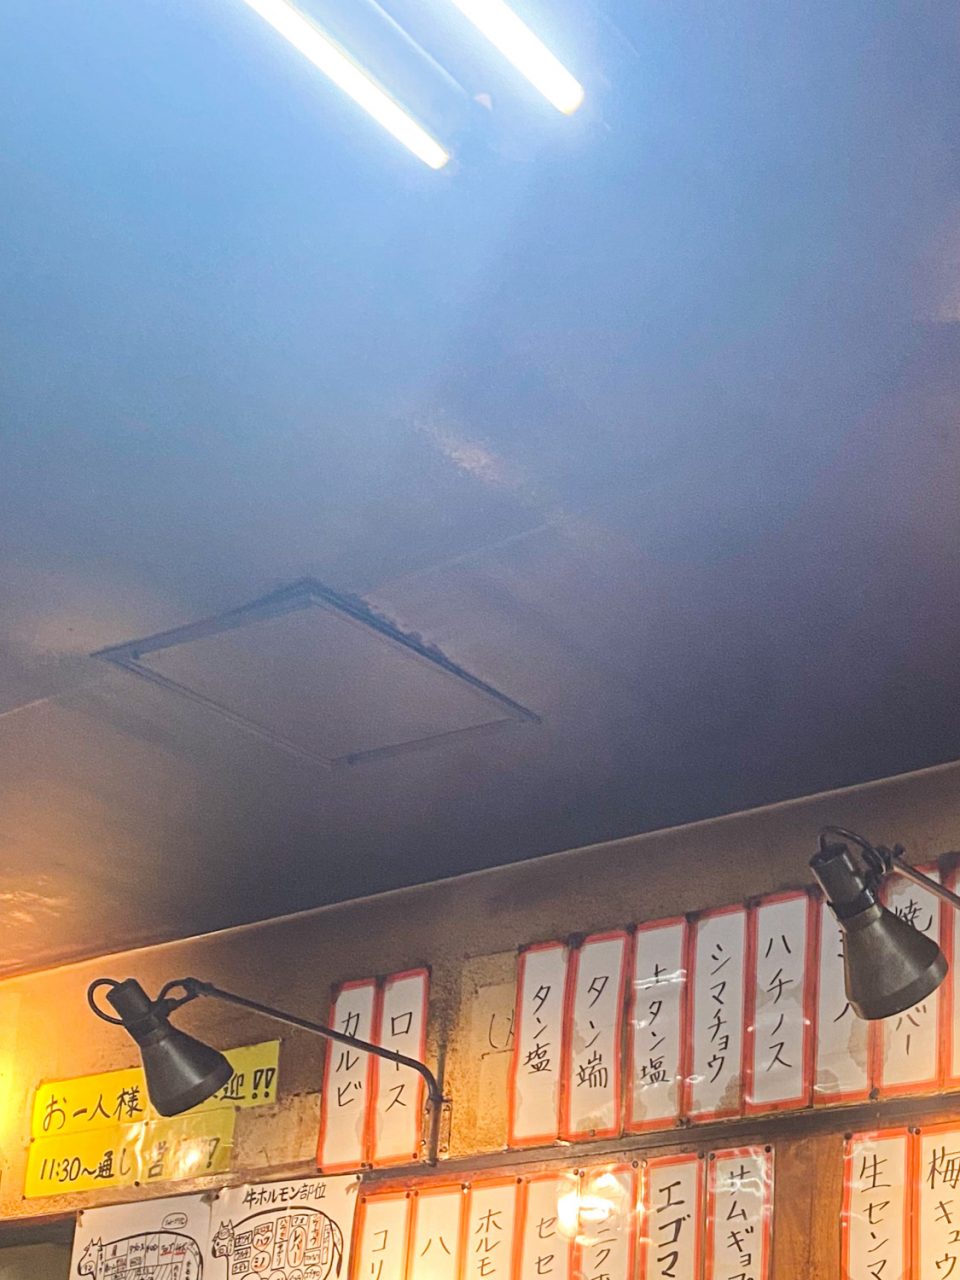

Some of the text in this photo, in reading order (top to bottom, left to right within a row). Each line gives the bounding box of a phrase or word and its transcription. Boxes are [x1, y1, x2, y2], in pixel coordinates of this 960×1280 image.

[522, 985, 552, 1075] タン塩
[576, 975, 609, 1088] タン端
[640, 964, 670, 1084] 上タン塩
[707, 943, 731, 1082] シマチョウ
[764, 934, 794, 1071] ハチノス
[895, 899, 934, 1055] 焼バー
[336, 1011, 363, 1107] カルビ
[386, 1011, 413, 1112] ロース
[242, 1184, 326, 1209] 牛ホルモン部位
